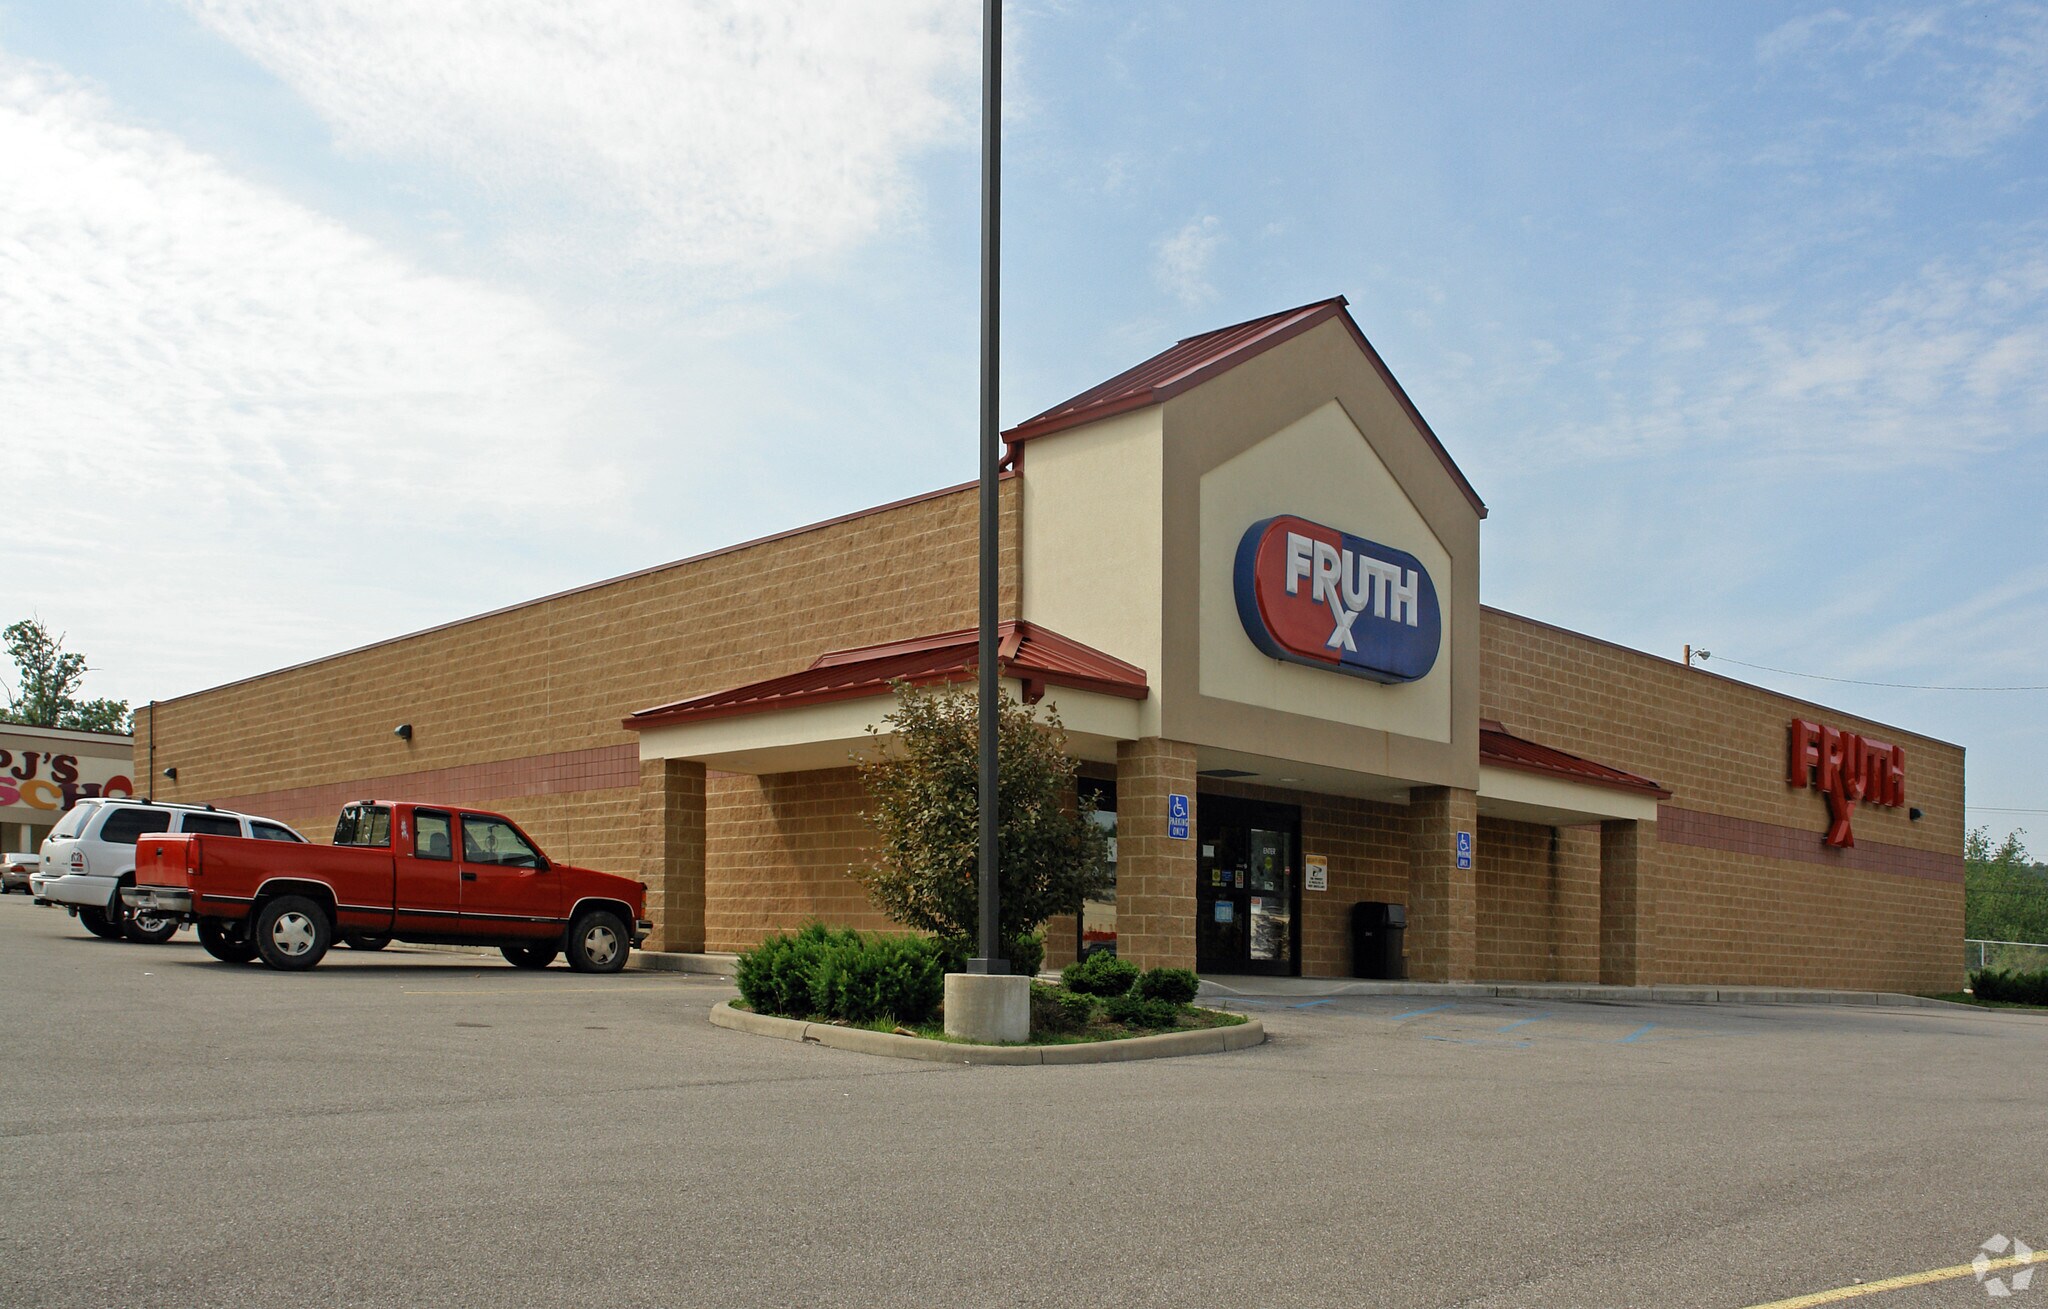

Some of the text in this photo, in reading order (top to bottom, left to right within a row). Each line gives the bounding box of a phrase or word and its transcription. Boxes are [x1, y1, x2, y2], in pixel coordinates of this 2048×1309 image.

[1286, 531, 1418, 628] FRUTH
[1791, 718, 1905, 808] FRUTH
[1170, 817, 1188, 827] PARKING
[1173, 827, 1185, 836] ONLY
